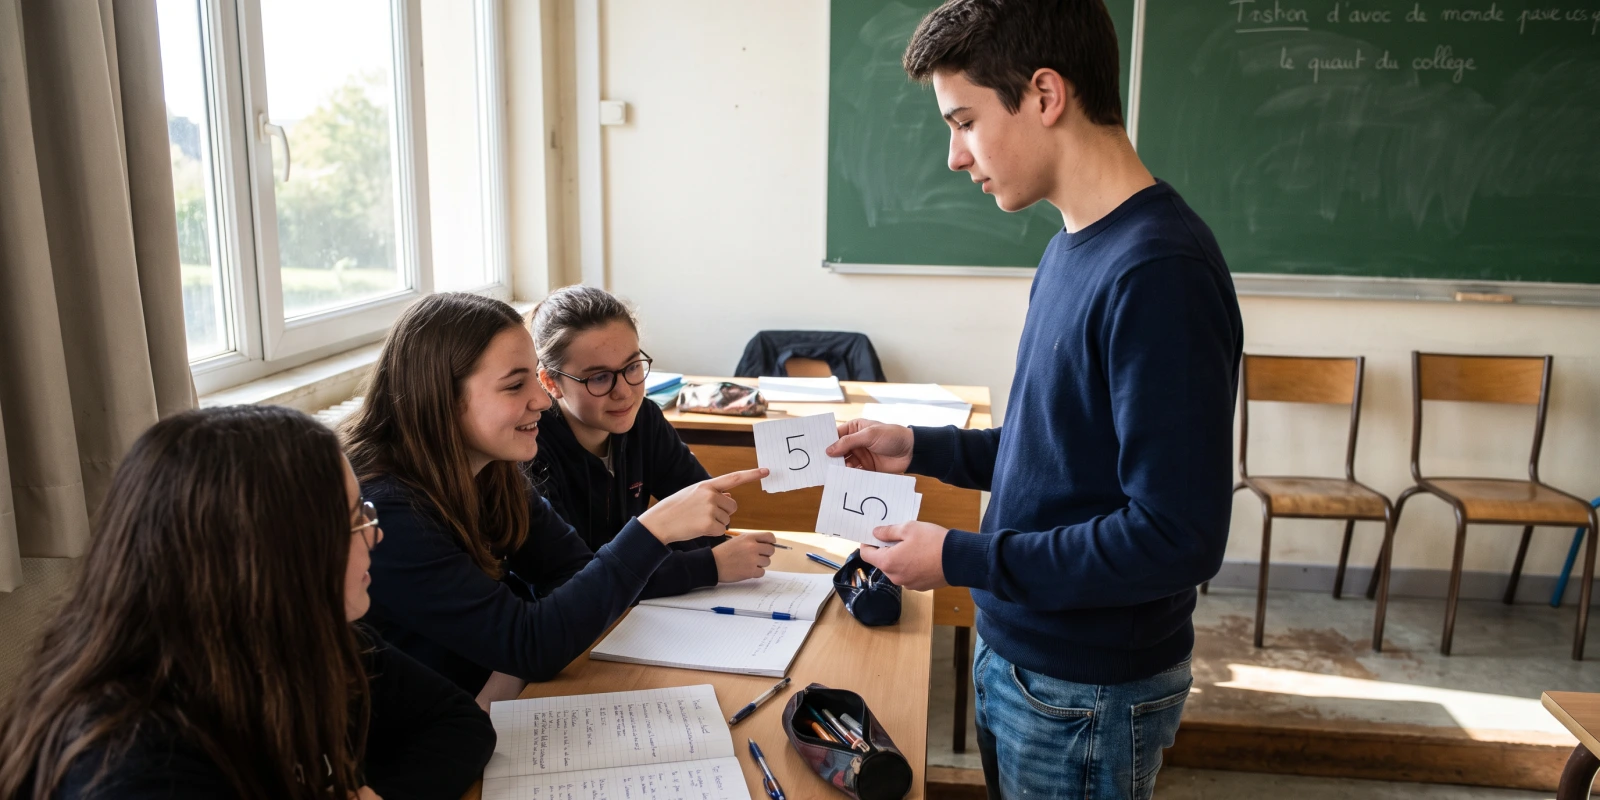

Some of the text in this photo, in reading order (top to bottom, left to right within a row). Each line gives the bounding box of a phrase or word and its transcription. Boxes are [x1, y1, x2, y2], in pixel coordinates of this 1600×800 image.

[1405, 2, 1428, 22] de
[1441, 2, 1504, 22] monde
[1280, 46, 1295, 69] le
[1375, 50, 1399, 70] du
[786, 434, 810, 471] 5
[843, 491, 888, 521] 5
